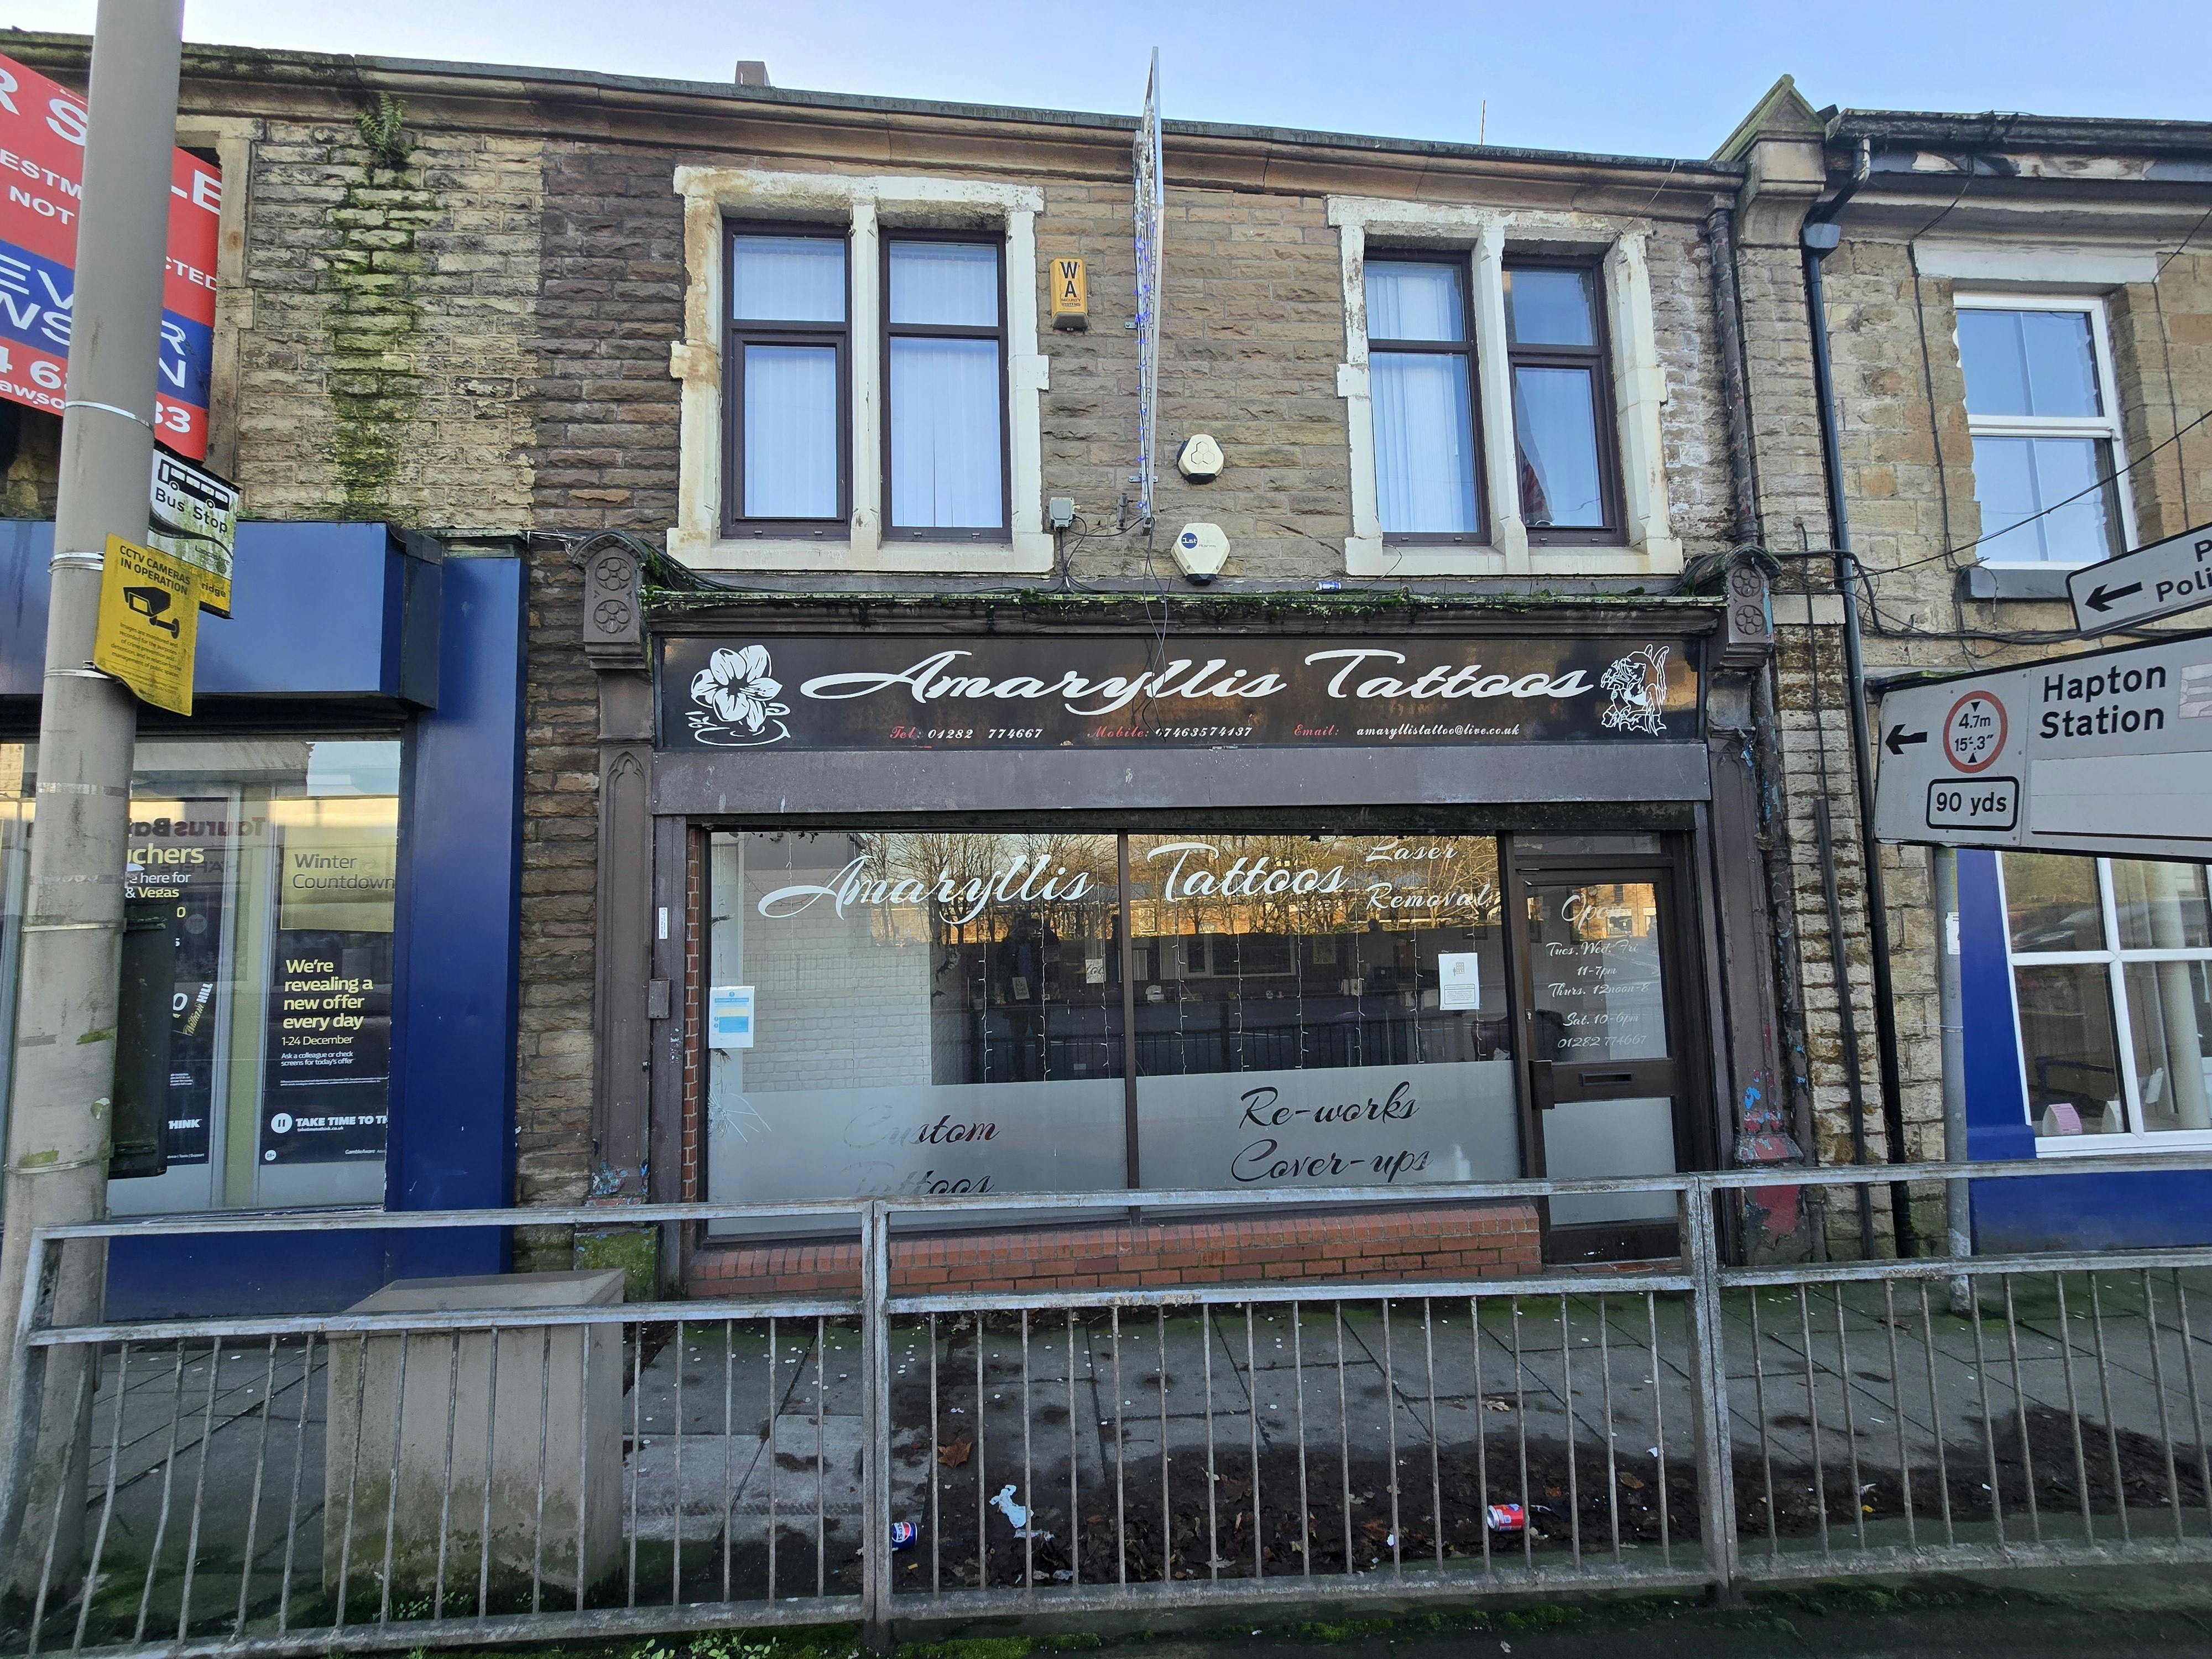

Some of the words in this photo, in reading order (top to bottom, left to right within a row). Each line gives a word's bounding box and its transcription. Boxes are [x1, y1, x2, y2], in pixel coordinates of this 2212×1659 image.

[10, 186, 75, 225] NOT
[156, 487, 185, 512] Bus
[193, 505, 227, 533] Stop
[119, 545, 145, 563] CCTV
[147, 557, 191, 585] CAMERAS
[121, 557, 132, 570] IN
[134, 564, 188, 595] OPERATION
[800, 650, 1287, 716] Amaryllis
[1305, 649, 1594, 700] Tattoos
[2043, 665, 2167, 703] Hapton
[1959, 713, 1991, 729] 4.7m
[2039, 705, 2164, 739] Station
[890, 726, 921, 739] Tel:
[928, 729, 973, 738] 01282
[988, 729, 1043, 738] 774667
[1087, 726, 1149, 738] Mobile:
[1293, 724, 1339, 736] Email:
[1936, 792, 1962, 812] 90
[1970, 791, 2007, 816] yds
[1366, 837, 1458, 862] Laser
[294, 853, 357, 868] Winter
[140, 873, 170, 883] here
[172, 872, 192, 883] for
[293, 874, 394, 889] Countdown
[758, 854, 1094, 925] Amaryllis
[1147, 842, 1349, 902] Tattoos
[138, 886, 179, 898] Vegas
[286, 959, 334, 973] We're
[1577, 966, 1617, 979] 11-7pm
[196, 983, 213, 1004] HILL
[285, 976, 359, 994] revealing
[362, 979, 373, 990] a
[1548, 983, 1586, 997] Thurs.
[284, 999, 320, 1010] new
[322, 994, 365, 1009] offer
[283, 1017, 330, 1031] every
[333, 1013, 364, 1030] day
[1563, 1012, 1589, 1026] Sat.
[281, 1036, 301, 1046] 1-24
[303, 1035, 354, 1045] December
[1558, 1036, 1601, 1048] 01282
[1239, 1081, 1420, 1129] Re-works
[295, 1117, 325, 1127] TAKE
[327, 1116, 356, 1126] TIME
[358, 1115, 374, 1125] TO
[843, 1105, 1000, 1148] Custom
[1232, 1139, 1433, 1182] Cover-ups
